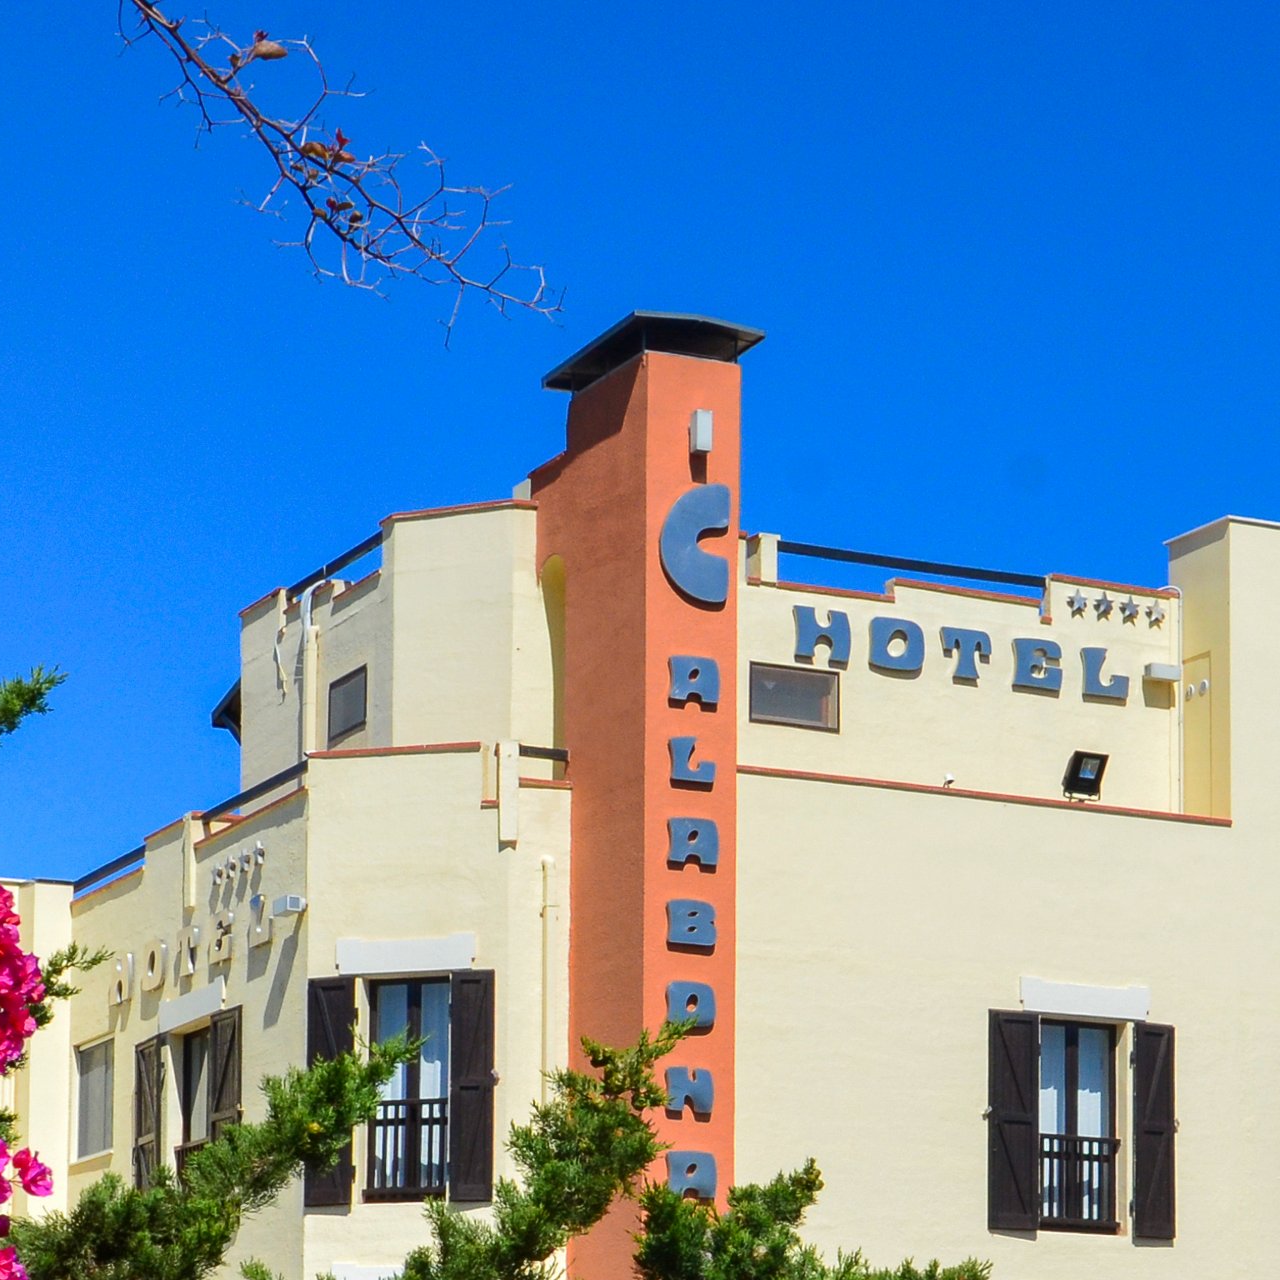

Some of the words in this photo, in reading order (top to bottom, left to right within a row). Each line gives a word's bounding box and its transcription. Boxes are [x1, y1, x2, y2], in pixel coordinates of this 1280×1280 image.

[793, 604, 1129, 701] HOTEL
[658, 482, 732, 1201] CALABONA
[108, 894, 272, 1005] HOTEL
